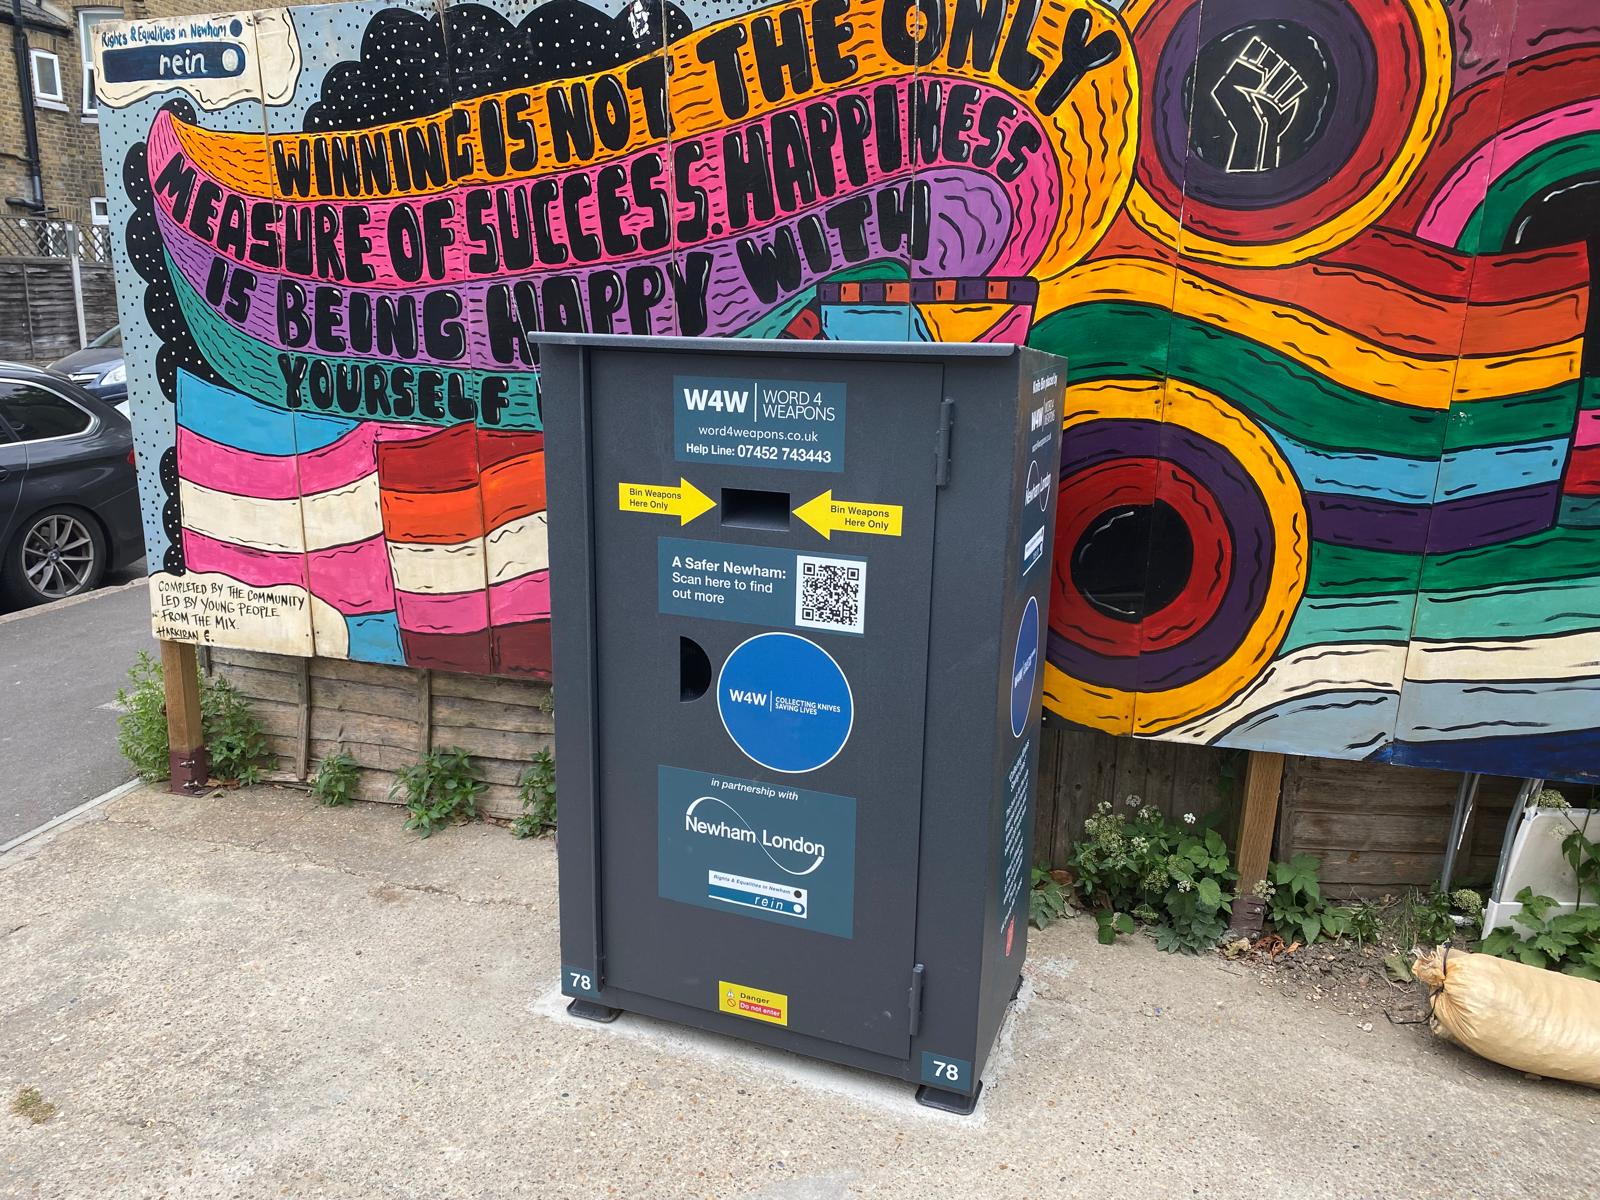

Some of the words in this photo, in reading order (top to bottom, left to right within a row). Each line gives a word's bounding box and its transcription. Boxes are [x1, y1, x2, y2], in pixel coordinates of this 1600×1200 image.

[102, 30, 128, 48] Rights
[138, 25, 176, 44] Equalities
[178, 27, 187, 39] in
[159, 48, 209, 76] rein
[273, 108, 474, 197] WINNING
[479, 93, 539, 177] IS
[546, 55, 676, 164] NOT
[696, 0, 858, 120] THE
[881, 0, 1122, 117] ONLY
[154, 152, 376, 284] MEASURE
[387, 199, 455, 282] OF
[722, 79, 1042, 228] HAPPINESS
[205, 256, 257, 323] IS
[276, 278, 467, 361] BEING
[485, 250, 714, 365] HAPPY
[735, 180, 932, 305] WITH
[277, 352, 510, 425] YOURSELF
[763, 389, 810, 406] WORD
[812, 391, 823, 407] 4
[683, 388, 749, 414] W4W
[763, 404, 836, 422] WEAPONS
[698, 426, 819, 443] word4weapons.co.uk
[686, 443, 709, 456] Help
[711, 444, 736, 456] Line:
[737, 444, 778, 460] 07452
[781, 447, 832, 464] 743443
[629, 488, 643, 497] Bin
[645, 489, 682, 501] Weapons
[629, 498, 647, 508] Here
[650, 500, 669, 512] Only
[830, 504, 845, 514] Bin
[848, 506, 890, 519] Weapons
[844, 517, 867, 528] Here
[868, 518, 889, 531] Only
[672, 556, 682, 569] A
[684, 556, 720, 573] Safer
[723, 561, 786, 580] Newham:
[672, 571, 702, 586] Scan
[705, 576, 731, 590] here
[733, 579, 747, 591] to
[749, 579, 773, 594] find
[158, 580, 207, 595] COMPLETED
[210, 582, 224, 597] BY
[227, 586, 245, 599] THE
[247, 589, 305, 610] COMMUNITY
[672, 587, 692, 600] out
[694, 591, 725, 604] more
[161, 594, 180, 608] LED
[184, 595, 198, 610] BY
[200, 598, 235, 615] YOUNG
[238, 603, 280, 619] PEOPLE
[161, 610, 189, 625] FROM
[192, 614, 211, 627] THE
[729, 688, 767, 707] W4W
[775, 696, 817, 710] COLLECTING
[817, 703, 841, 713] KNIVES
[775, 703, 799, 713] SAVING
[799, 707, 818, 716] LIVES
[711, 777, 720, 787] in
[721, 779, 776, 798] partnership
[778, 789, 799, 801] with
[685, 815, 756, 844] Newham
[762, 829, 825, 857] London
[754, 896, 784, 910] rein
[570, 972, 592, 990] 78
[740, 992, 770, 1004] Danger
[740, 1002, 750, 1010] Do
[750, 1005, 762, 1013] not
[763, 1008, 781, 1017] enter
[933, 1060, 959, 1081] 78
